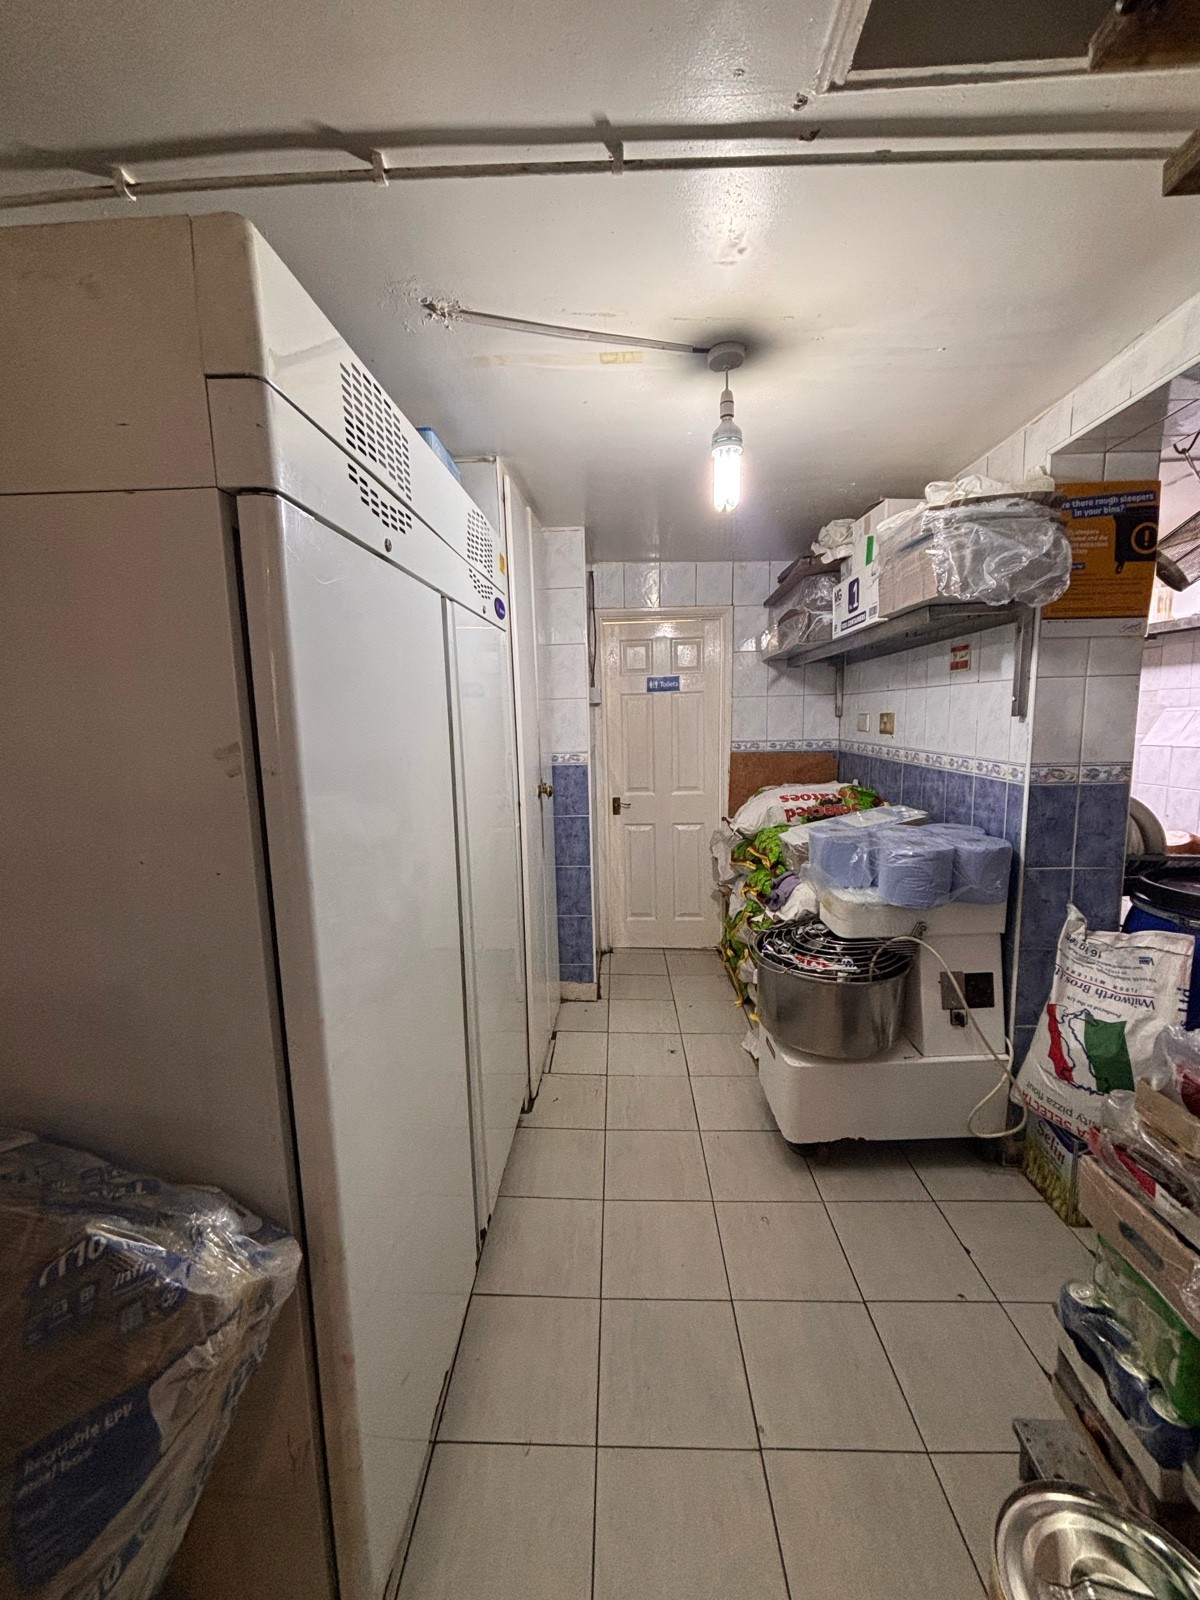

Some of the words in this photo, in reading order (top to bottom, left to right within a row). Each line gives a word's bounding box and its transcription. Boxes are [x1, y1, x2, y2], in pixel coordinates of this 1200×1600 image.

[1061, 501, 1070, 509] re
[1071, 499, 1094, 508] there
[1095, 495, 1119, 506] rough
[1120, 493, 1154, 503] sleepers
[1074, 509, 1082, 517] in
[1084, 507, 1102, 518] your
[1103, 505, 1125, 514] bins?
[660, 681, 679, 689] Toilets
[1090, 948, 1102, 959] 16
[1025, 1081, 1044, 1100] flour
[1046, 1096, 1073, 1118] pizza
[1037, 1119, 1065, 1165] Selin
